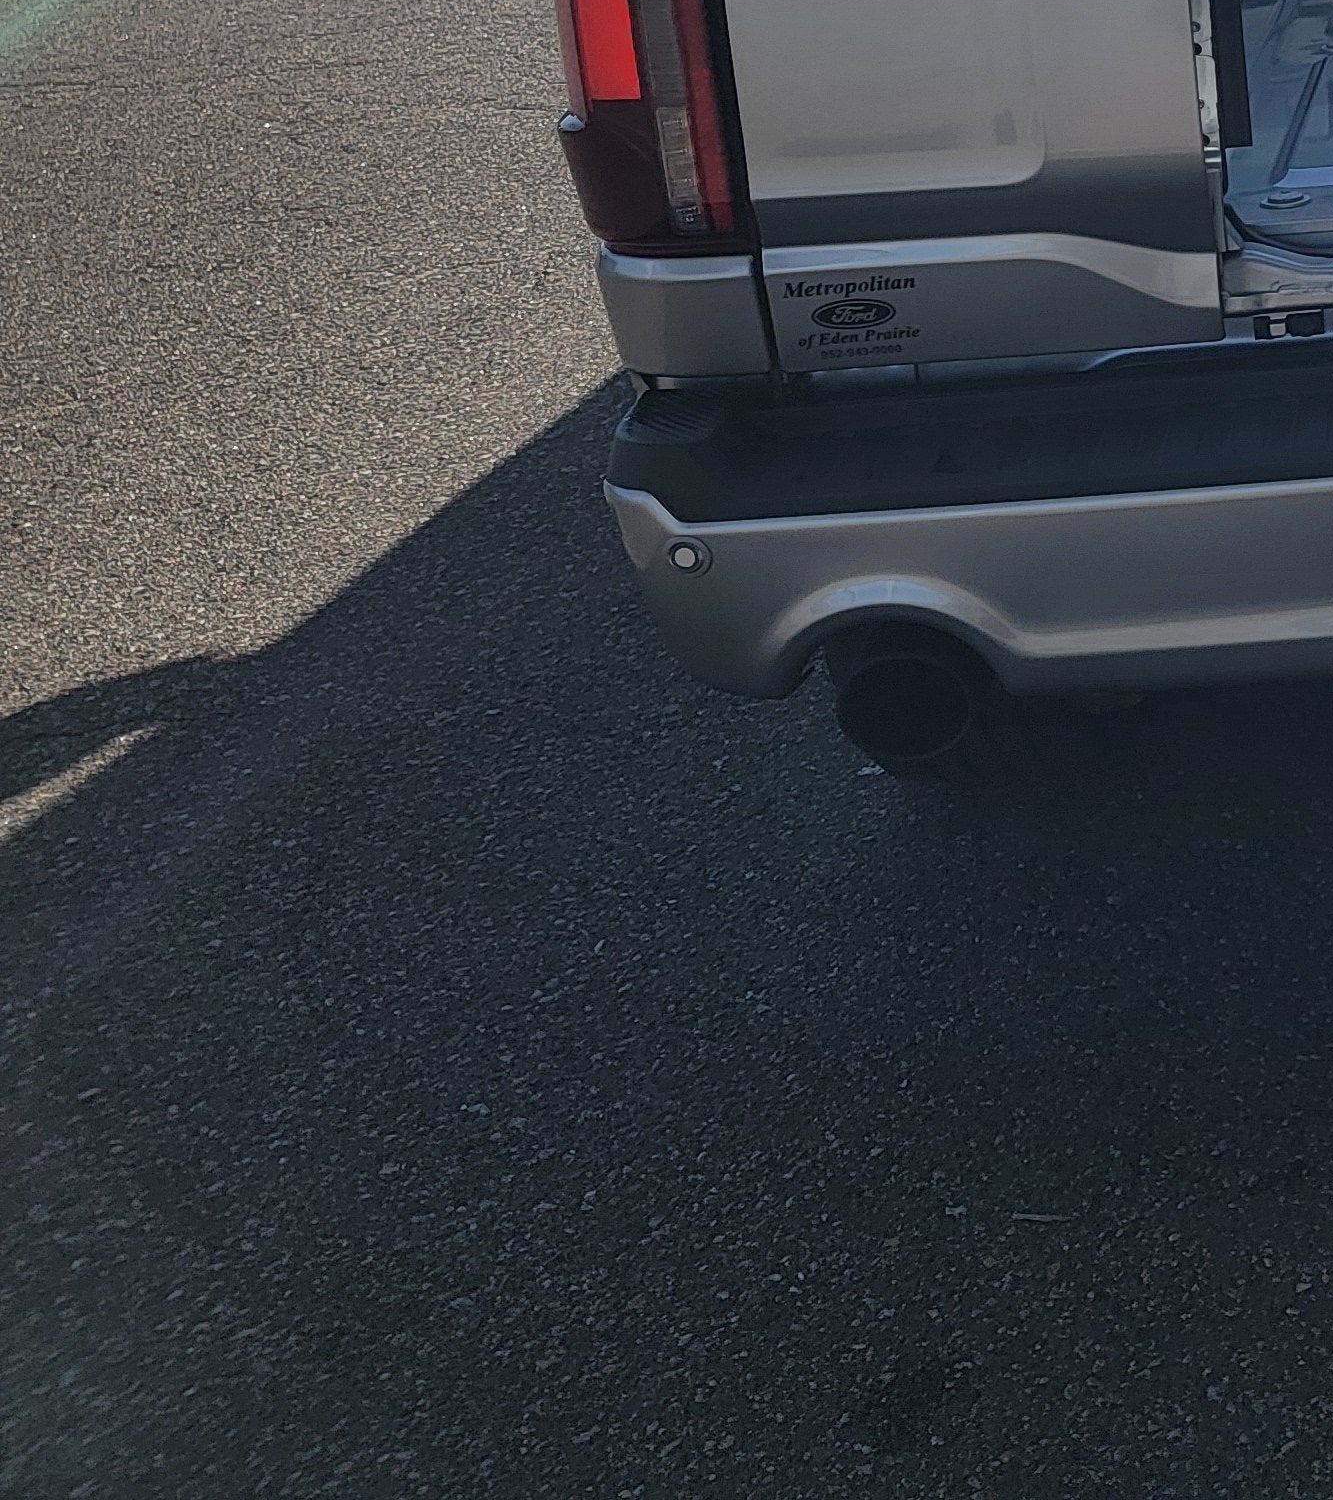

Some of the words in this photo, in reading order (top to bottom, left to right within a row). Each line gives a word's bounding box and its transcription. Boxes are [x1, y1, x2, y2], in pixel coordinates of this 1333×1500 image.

[783, 275, 916, 298] Metropolitan
[831, 305, 877, 323] Ford
[798, 332, 816, 349] of
[819, 332, 859, 346] Eden
[865, 325, 921, 342] Prairie
